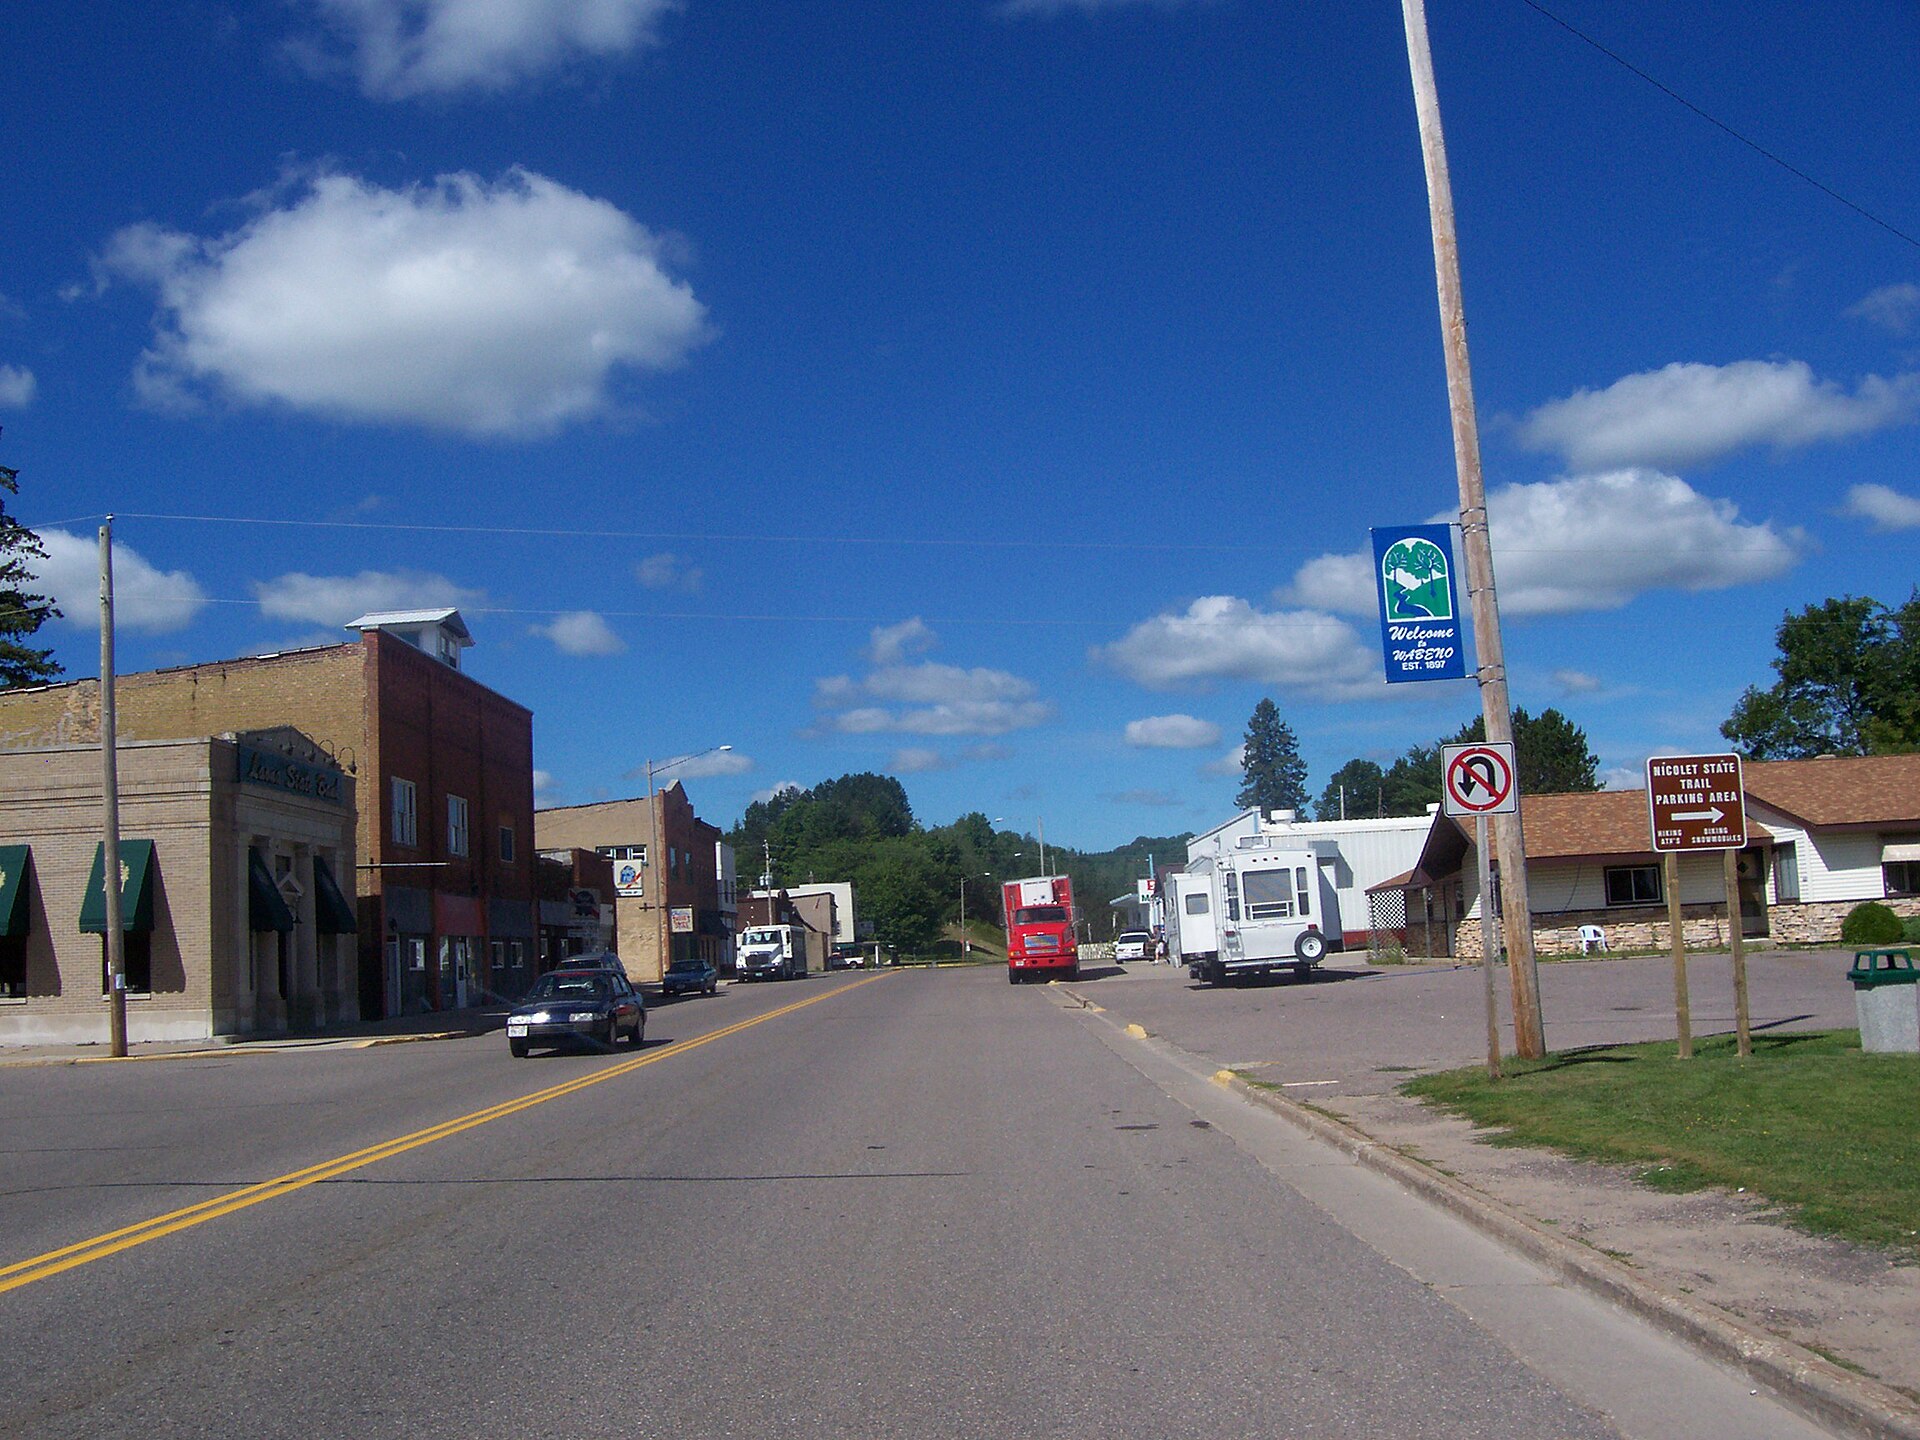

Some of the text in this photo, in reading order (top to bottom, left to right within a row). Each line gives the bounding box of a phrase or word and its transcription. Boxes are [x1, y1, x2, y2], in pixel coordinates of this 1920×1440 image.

[1389, 626, 1454, 640] Welcome
[1392, 647, 1454, 661] WABENO
[1402, 660, 1446, 670] EST. 1897
[1653, 763, 1735, 776] NICOLET STATE
[1680, 778, 1712, 789] TRAIL
[1656, 791, 1738, 805] PARKING AREA
[1657, 829, 1682, 837] HIKING
[1691, 835, 1742, 844] SNOWMOBILES
